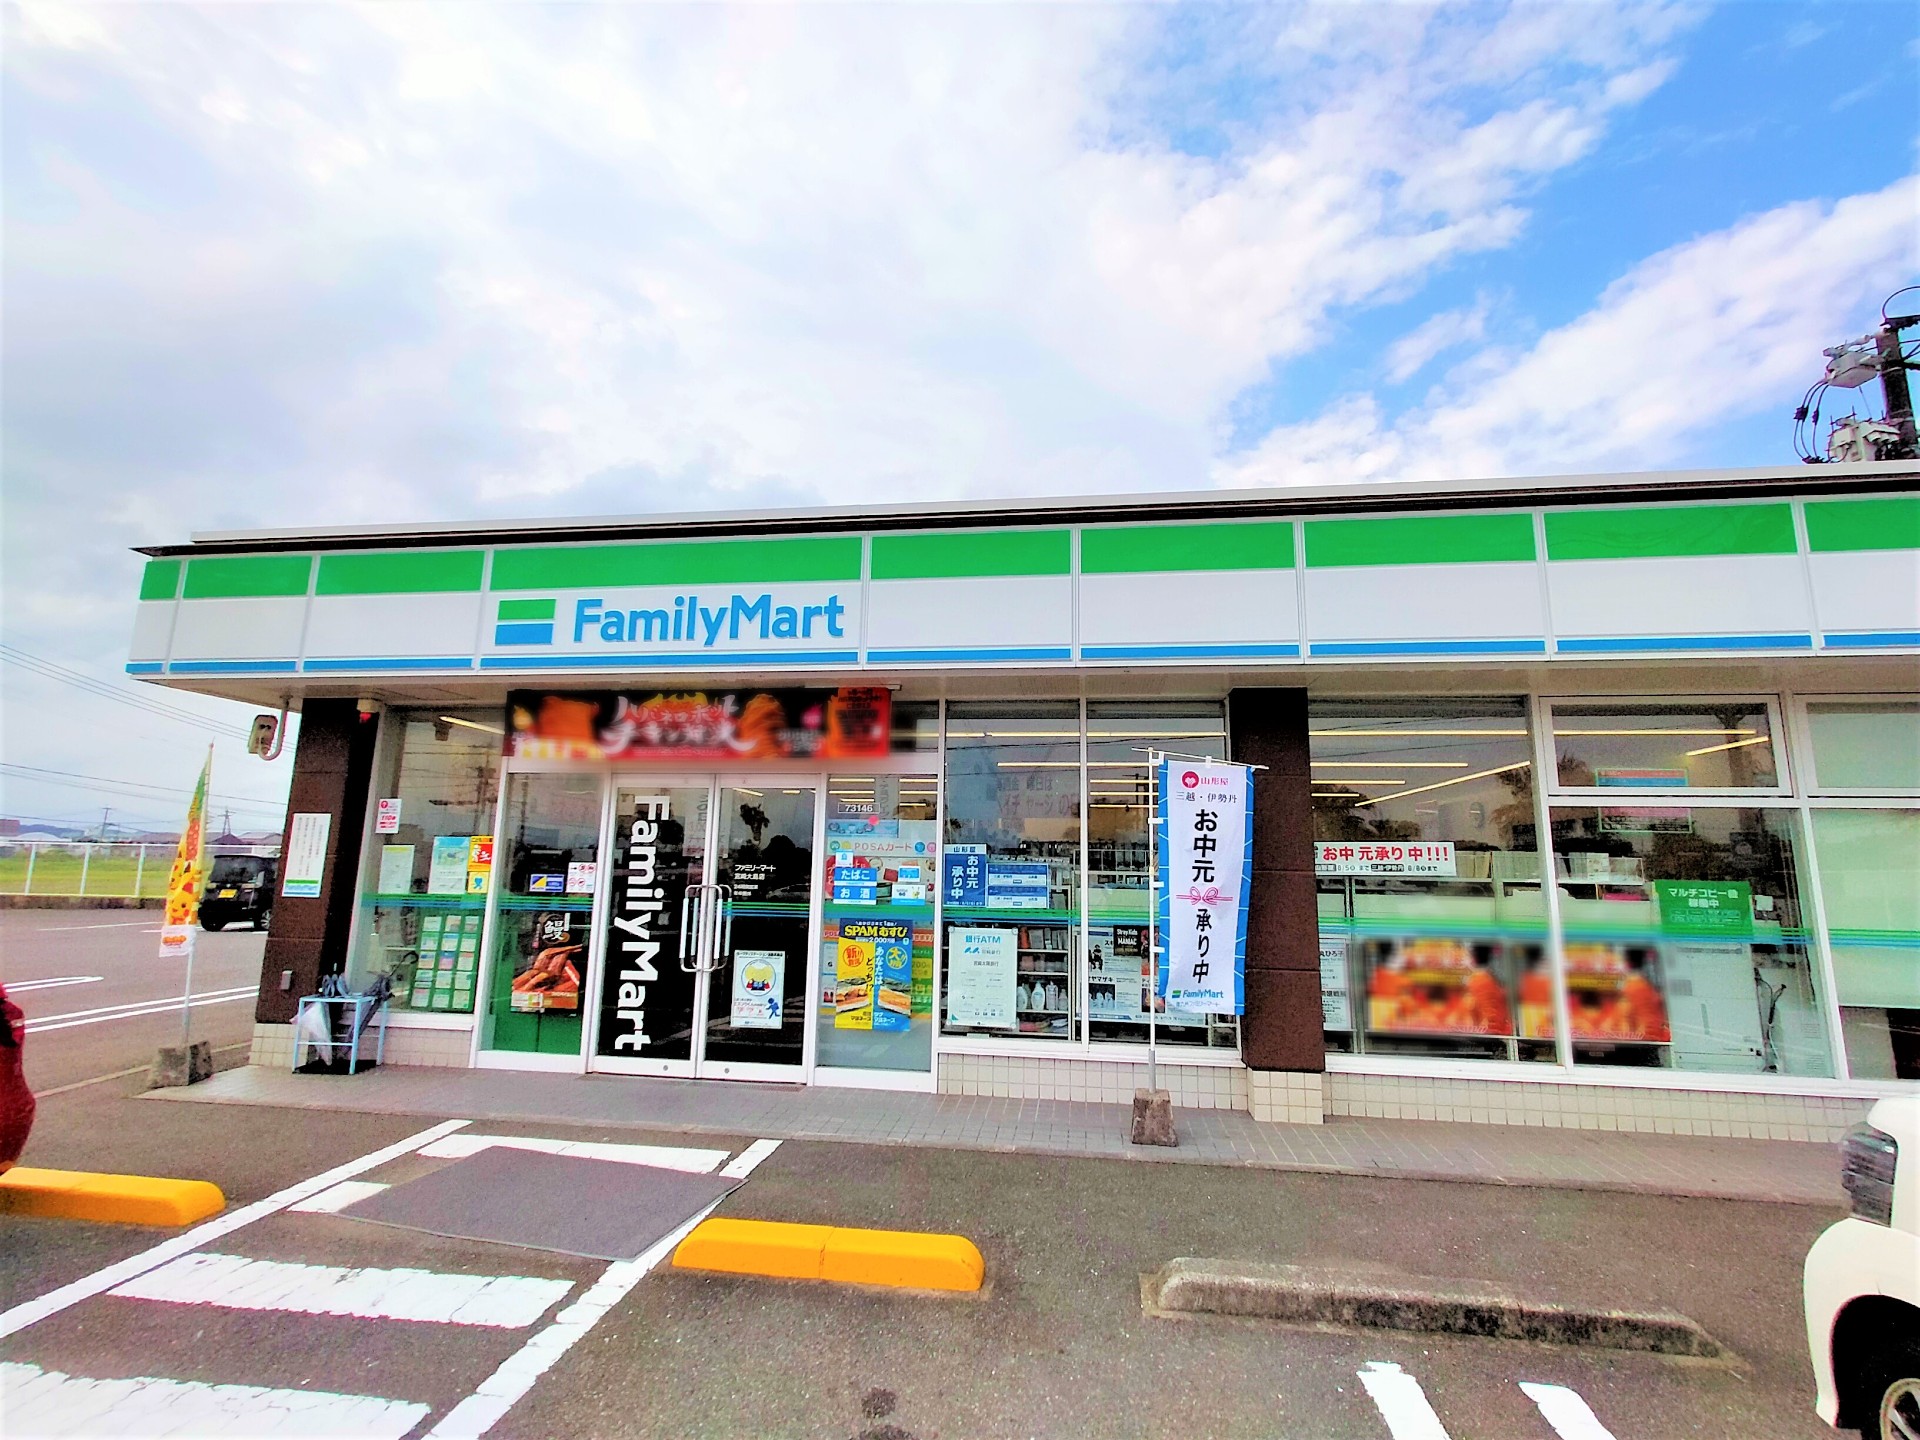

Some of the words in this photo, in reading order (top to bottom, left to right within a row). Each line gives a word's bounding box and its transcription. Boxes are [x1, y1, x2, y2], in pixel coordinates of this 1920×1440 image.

[574, 594, 845, 647] FamilyMart
[1176, 791, 1237, 803] 三越・伊勢丹
[845, 804, 873, 812] 73146
[854, 842, 912, 852] POSAカード
[1191, 808, 1218, 883] お中元
[735, 864, 776, 872] ファミリーマート
[841, 870, 870, 880] たばこ
[966, 855, 979, 889] お中元
[951, 866, 965, 899] 承り中
[840, 888, 870, 899] お酒
[542, 920, 565, 941] 鰻
[614, 795, 670, 1051] FamilyMart
[1192, 908, 1213, 984] 承り中
[874, 946, 885, 985] あなたは
[1183, 989, 1223, 998] FamilyMart
